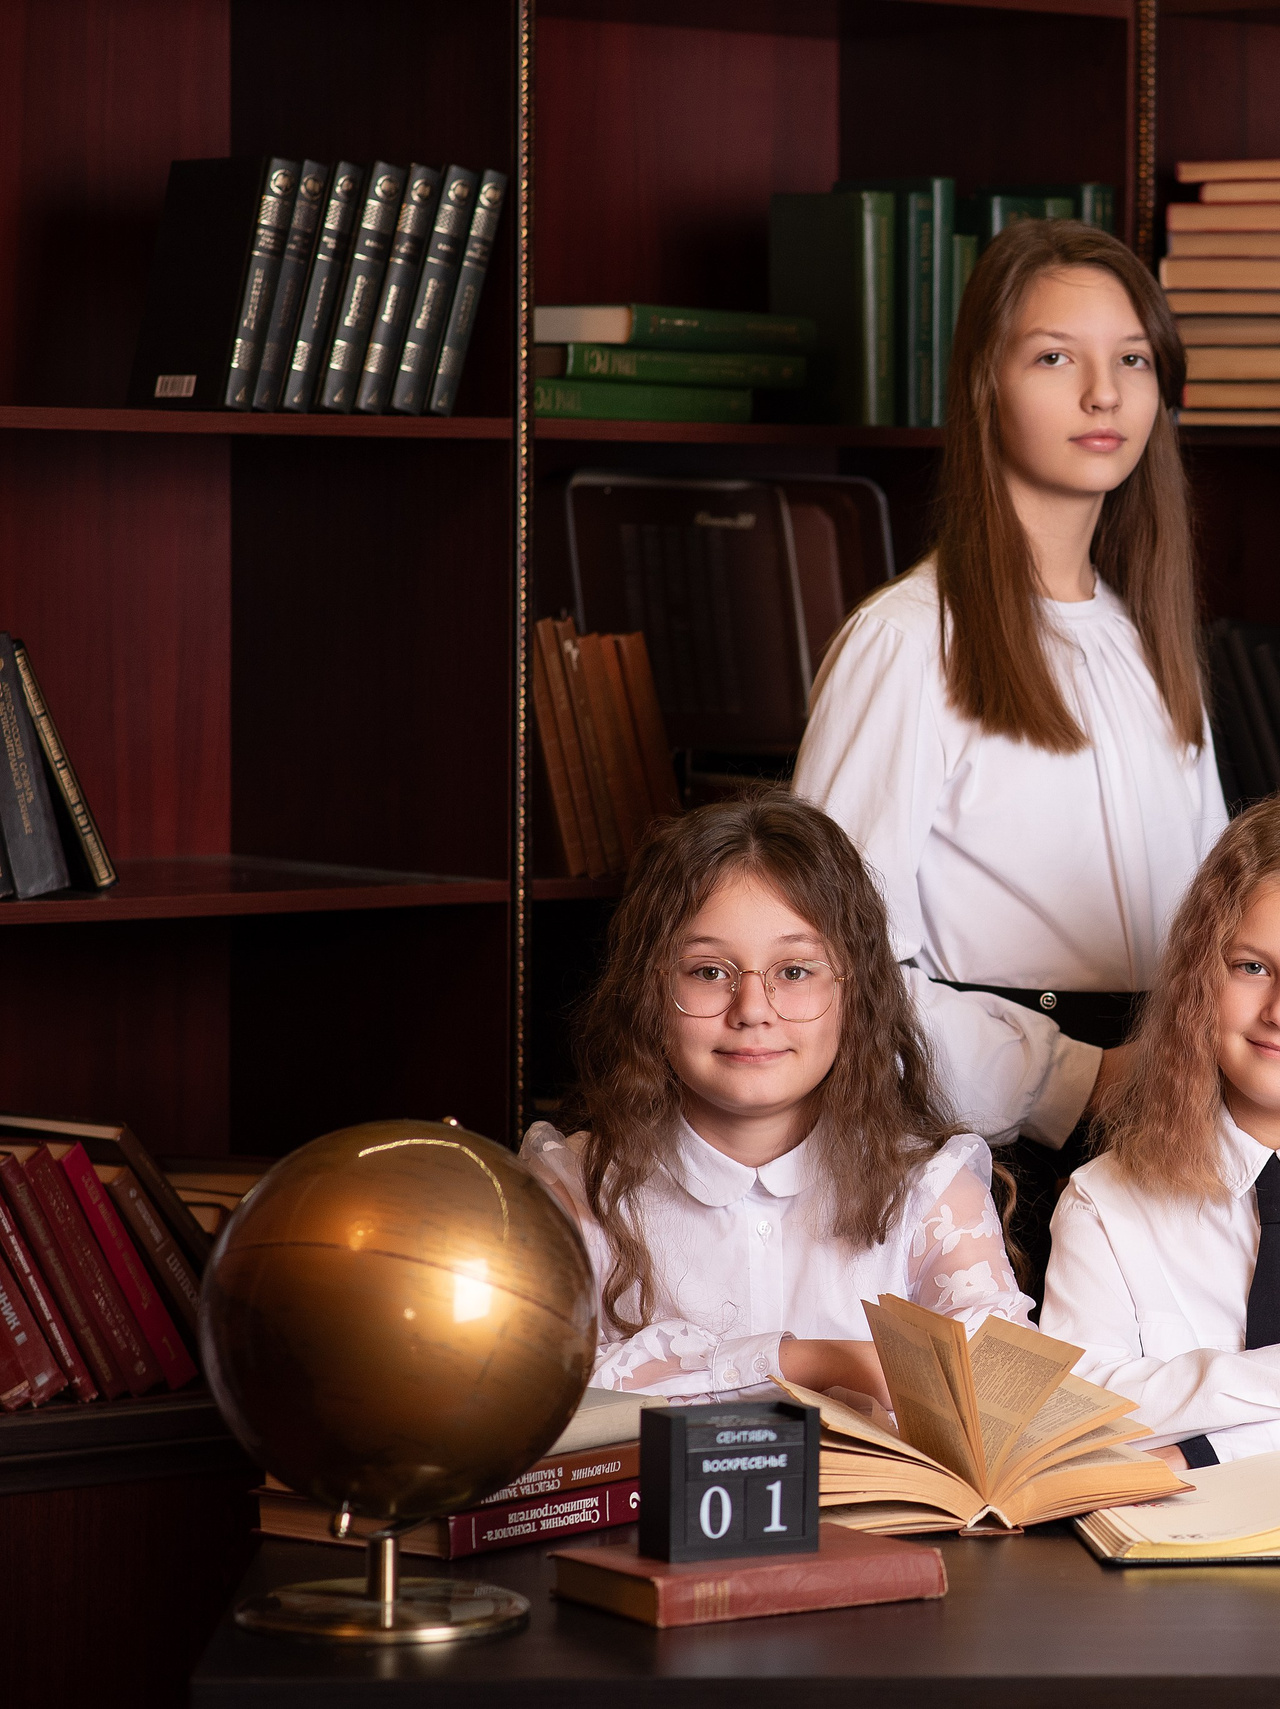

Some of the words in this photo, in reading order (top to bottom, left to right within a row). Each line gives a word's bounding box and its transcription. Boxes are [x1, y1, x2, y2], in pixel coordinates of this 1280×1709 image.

[716, 1430, 777, 1444] СЕНТЯБРЬ
[556, 1466, 564, 1477] В
[570, 1460, 621, 1481] СПРАВОЧНИК
[702, 1454, 787, 1473] ВОСКРЕСЕНЬЕ
[519, 1478, 561, 1494] СРЕДСТВА
[508, 1496, 599, 1523] машиностроителя
[539, 1510, 601, 1531] Справочник
[482, 1520, 537, 1542] технолога-
